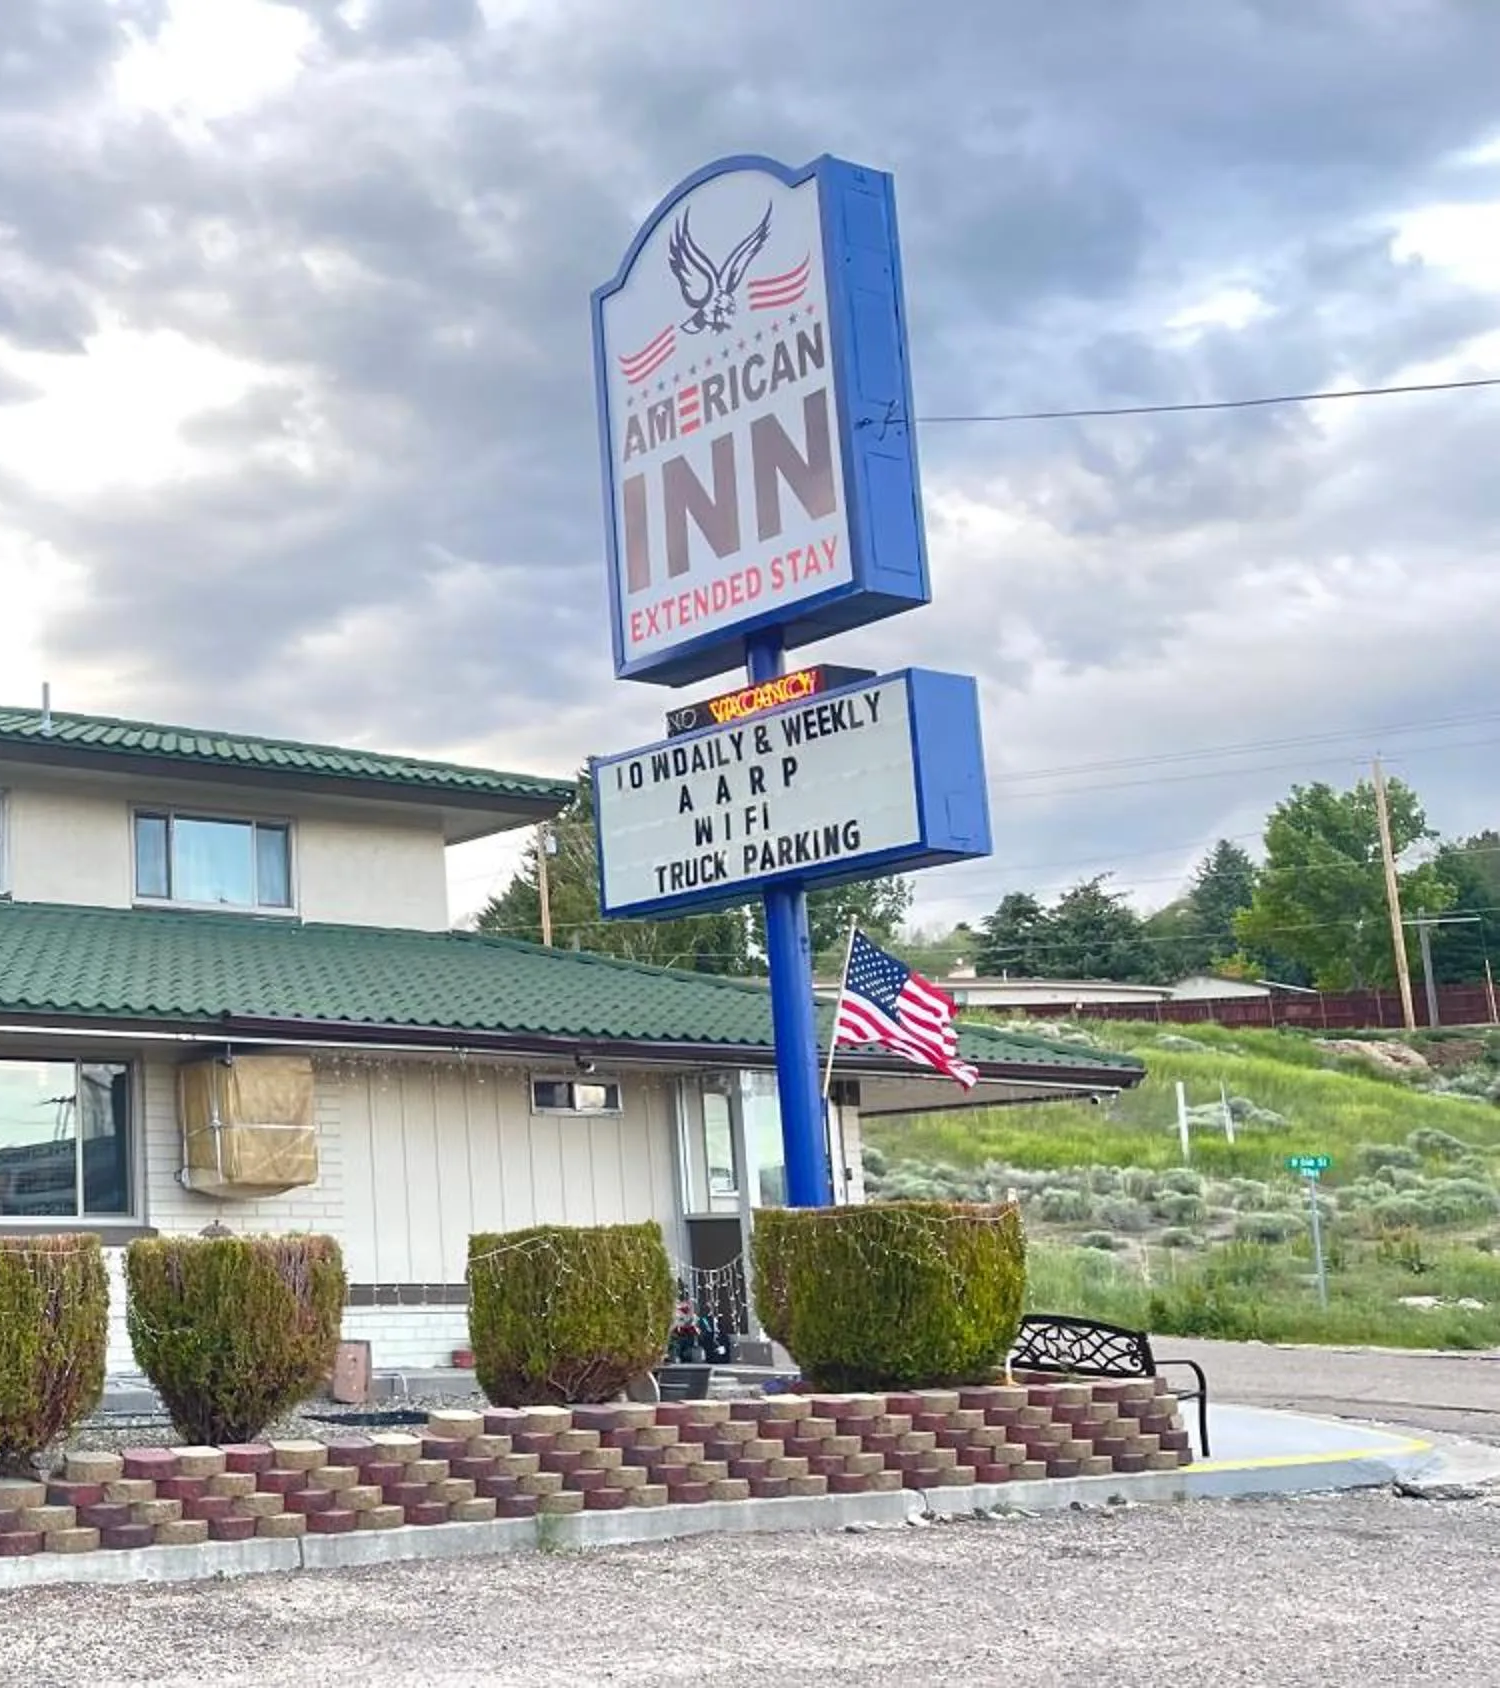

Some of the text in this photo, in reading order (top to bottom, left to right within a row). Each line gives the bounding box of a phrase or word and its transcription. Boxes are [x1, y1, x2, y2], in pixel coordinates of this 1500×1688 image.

[623, 322, 826, 462] AMERICAN
[623, 387, 838, 595] INN
[631, 536, 838, 643] EXTENDED STAY
[708, 671, 816, 724] VACANCY
[754, 725, 773, 754] &
[782, 691, 882, 747] WEEKLY
[655, 820, 861, 894] TRUCK PARKING
